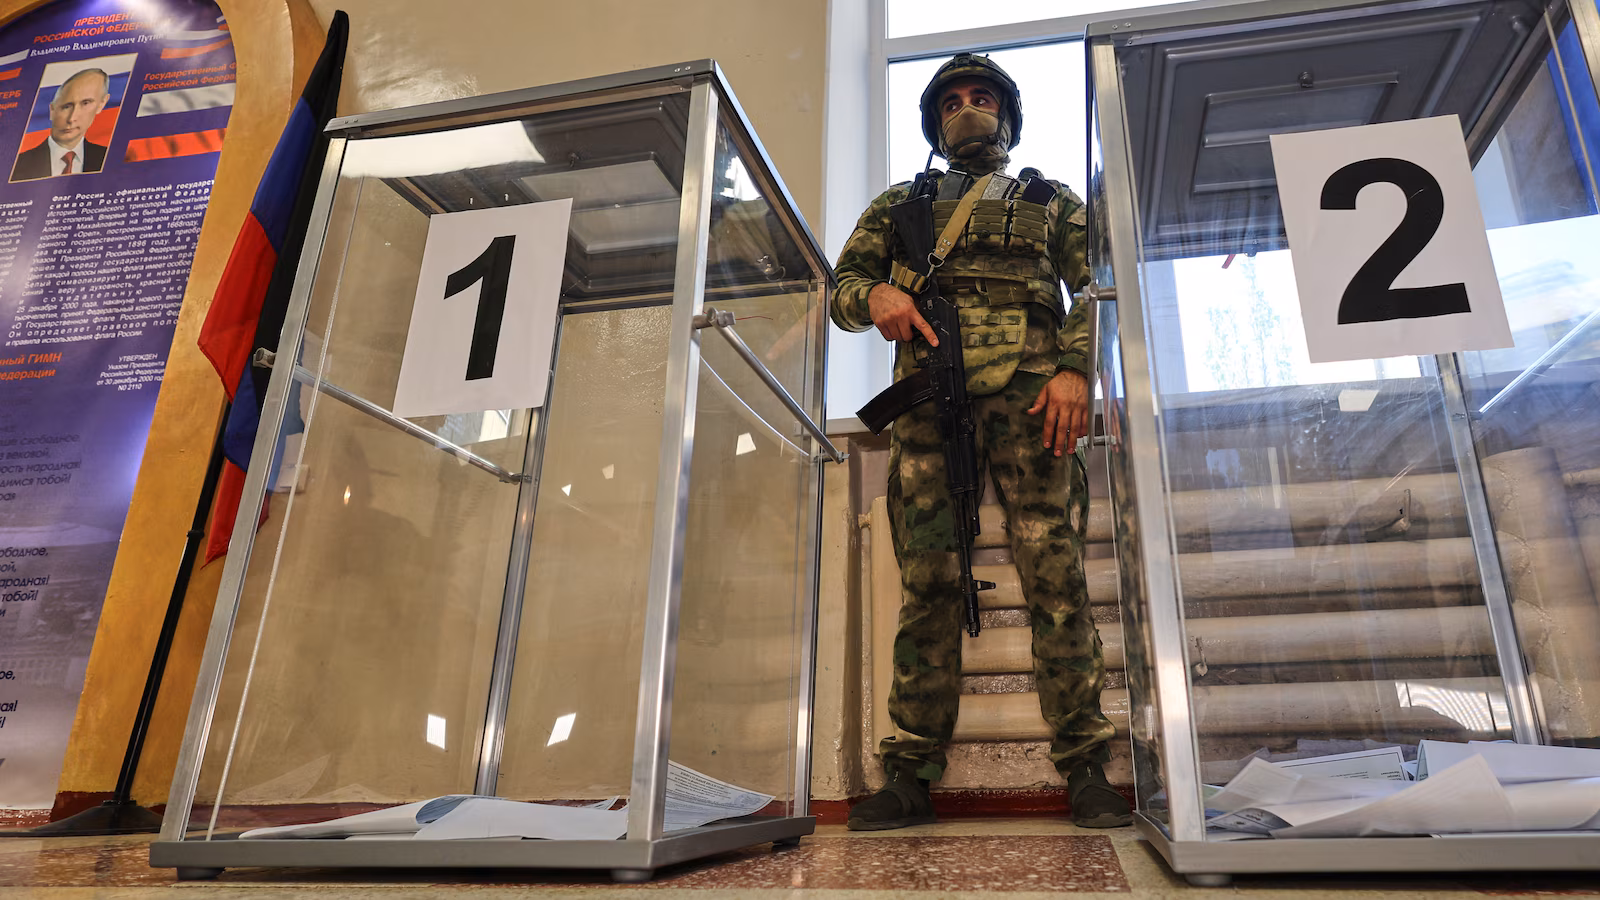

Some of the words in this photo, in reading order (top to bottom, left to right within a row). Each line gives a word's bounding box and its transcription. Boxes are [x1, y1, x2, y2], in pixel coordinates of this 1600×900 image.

[33, 25, 104, 44] РОССИЙСКОЙ
[30, 44, 70, 57] Владимир
[72, 37, 135, 50] Владимирович
[144, 63, 227, 81] Государственный
[142, 79, 198, 91] Российской
[116, 184, 172, 197] официальный
[47, 209, 77, 217] История
[81, 205, 125, 214] Российского
[129, 200, 166, 210] триколора
[98, 212, 127, 221] Впервые
[142, 208, 157, 216] был
[159, 206, 183, 214] поднят
[41, 225, 72, 233] Алексея
[76, 220, 125, 230] Михайловича
[142, 215, 169, 224] первом
[173, 211, 202, 221] русском
[106, 225, 153, 235] построенном
[71, 234, 135, 246] государственного
[139, 231, 170, 239] символа
[1320, 157, 1472, 325] 2
[60, 253, 101, 263] Президента
[105, 248, 144, 258] Российской
[149, 244, 187, 253] Федерации
[77, 245, 104, 254] спустя
[128, 240, 147, 248] 1896
[44, 271, 70, 279] каждой
[71, 269, 96, 277] полосы
[97, 266, 121, 275] нашего
[123, 264, 144, 273] флага
[145, 262, 166, 270] имеет
[166, 259, 191, 268] особое
[70, 261, 99, 270] череду
[103, 253, 173, 266] государственных
[56, 274, 120, 286] символизирует
[57, 287, 76, 295] веру
[139, 276, 172, 287] красный
[28, 303, 58, 312] декабря
[61, 302, 79, 310] 2000
[102, 298, 135, 306] накануне
[139, 295, 162, 303] нового
[443, 234, 516, 381] 1
[61, 310, 85, 319] принят
[86, 305, 134, 316] Федеральный
[25, 318, 89, 329] Государственном
[92, 315, 115, 324] флаге
[119, 311, 162, 321] Российской
[8, 330, 21, 338] Он
[11, 338, 40, 347] правила
[41, 334, 93, 344] использования
[94, 331, 116, 340] флага
[28, 352, 62, 364] ГИМН
[118, 353, 158, 362] УТВЕРЖДЕН
[129, 361, 165, 369] Президента
[100, 370, 134, 378] Российской
[127, 383, 143, 391] 2110
[0, 465, 24, 473] ость
[26, 458, 82, 473] народная!
[37, 473, 72, 486] тобой!
[0, 561, 17, 573] ой,
[2, 590, 39, 602] тобой!
[0, 700, 18, 712] ая!
